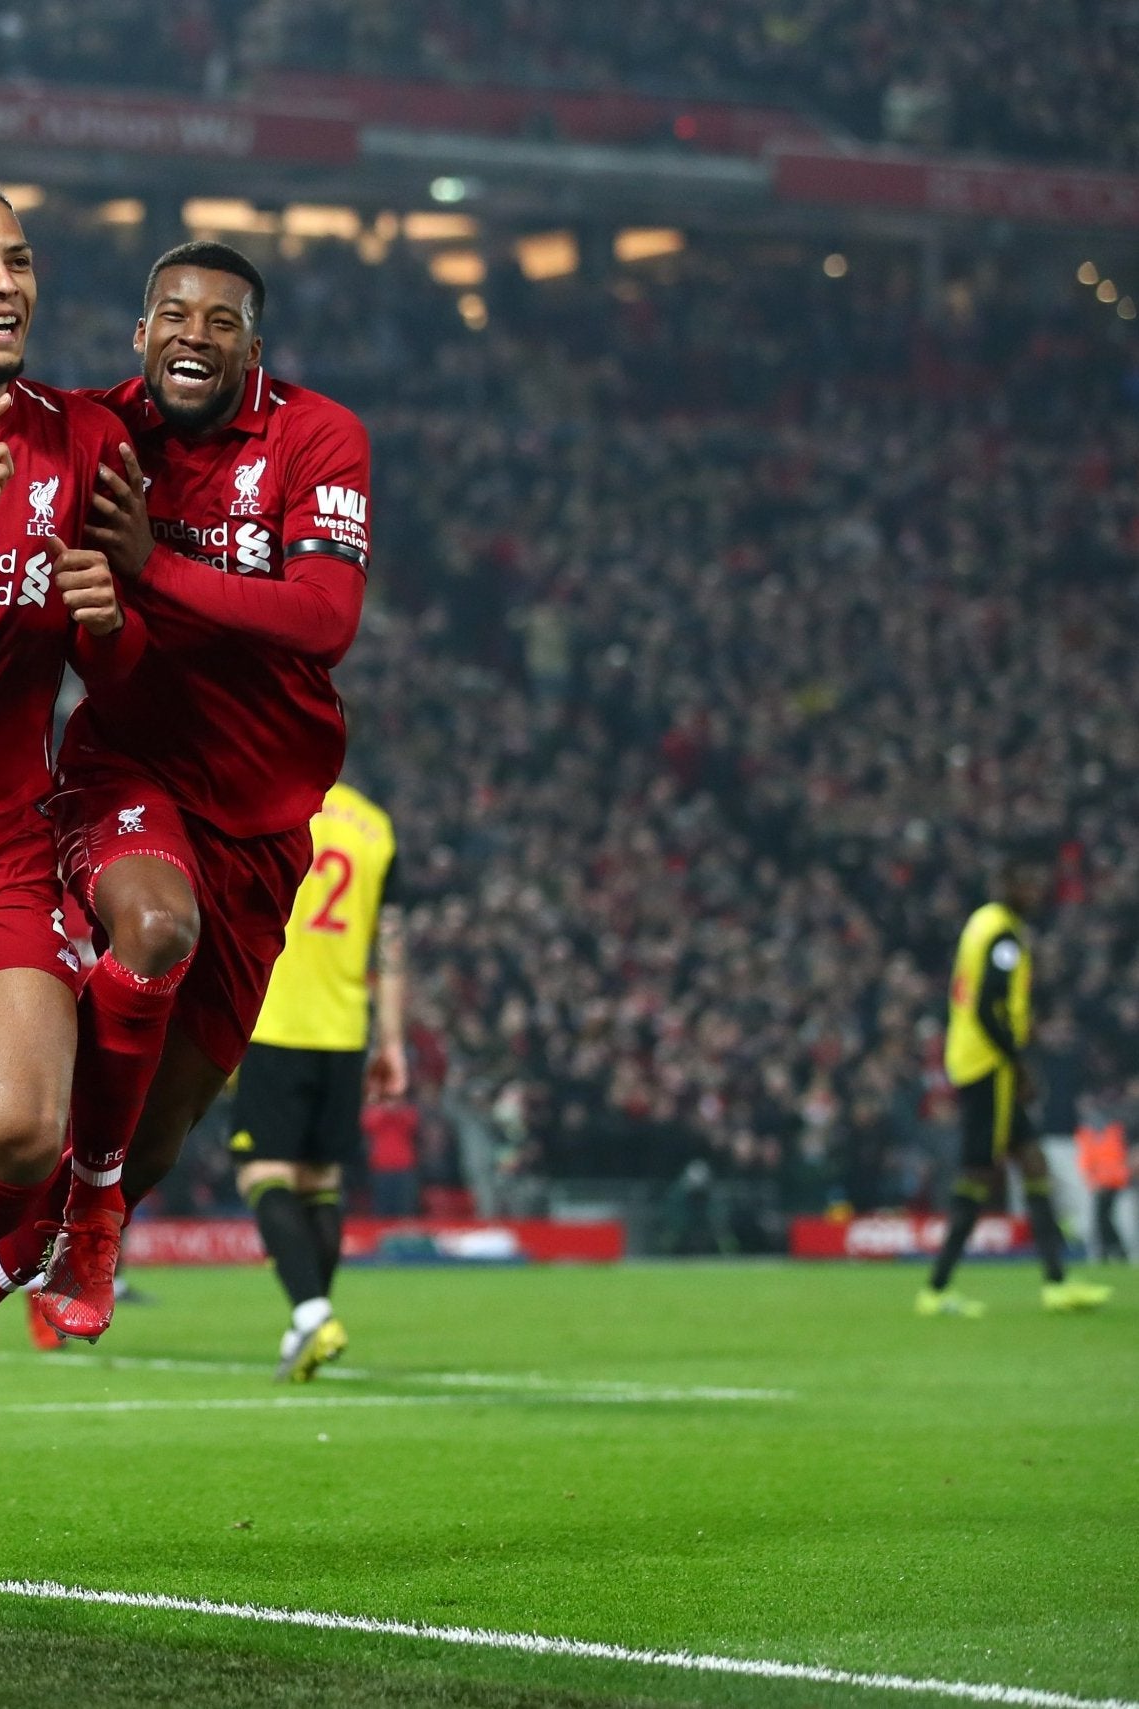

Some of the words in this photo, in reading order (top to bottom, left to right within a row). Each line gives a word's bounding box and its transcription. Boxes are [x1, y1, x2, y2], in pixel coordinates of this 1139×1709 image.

[315, 485, 367, 524] WU
[153, 519, 228, 546] ndard
[313, 515, 366, 540] Western
[331, 529, 368, 552] Union
[311, 849, 352, 934] 2
